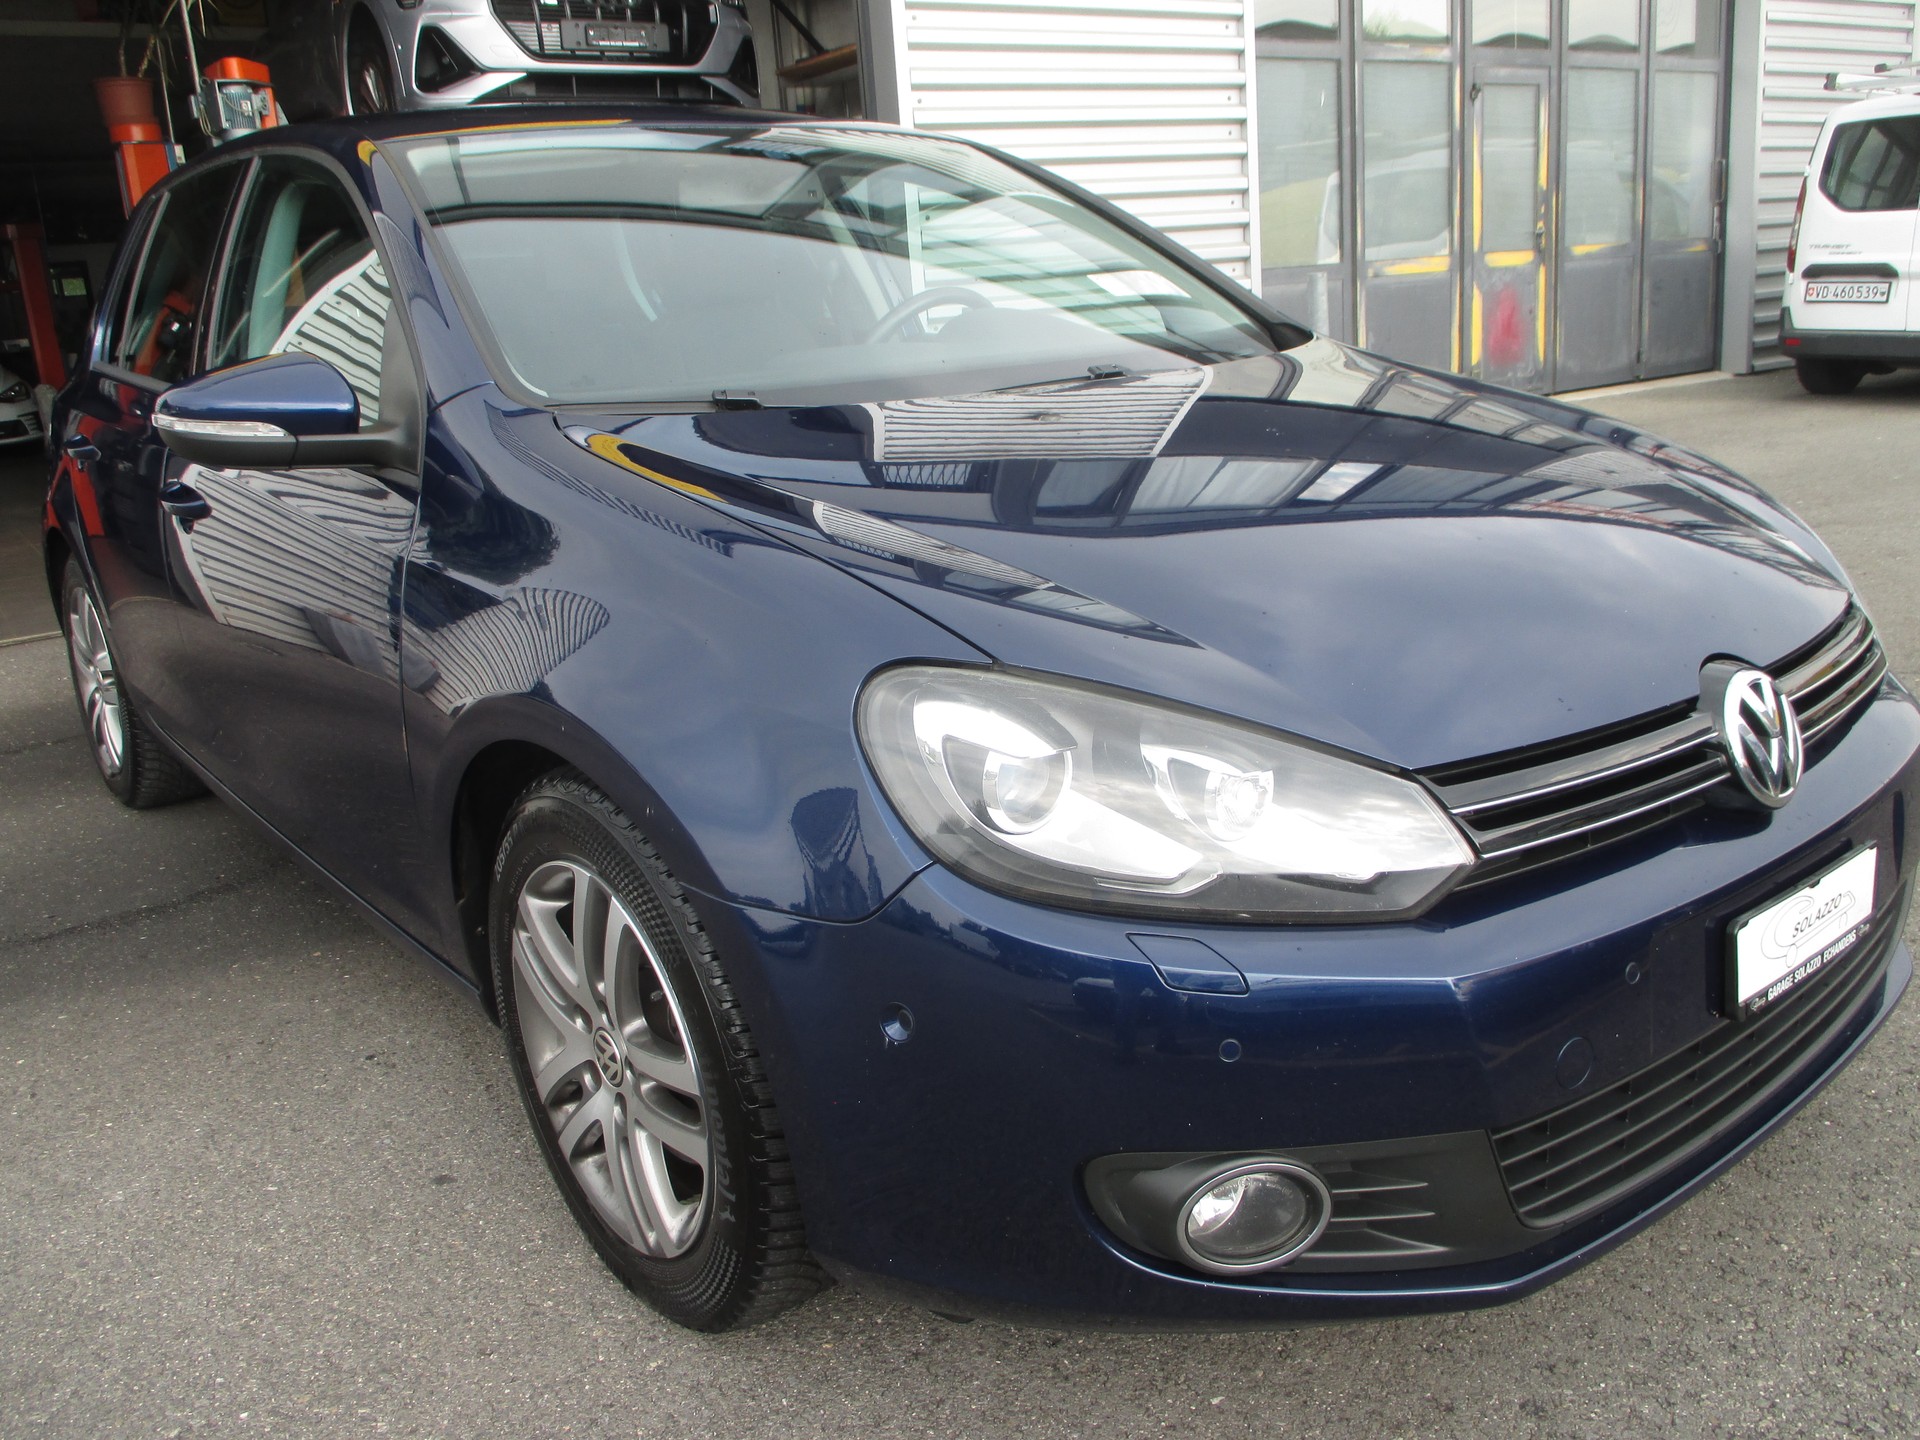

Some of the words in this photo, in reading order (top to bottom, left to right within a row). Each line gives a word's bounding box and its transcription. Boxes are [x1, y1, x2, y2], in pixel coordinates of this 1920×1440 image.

[1792, 893, 1842, 938] SOLAZZO
[1767, 974, 1794, 1001] GARAGE
[1794, 955, 1822, 983] SOLAZZO
